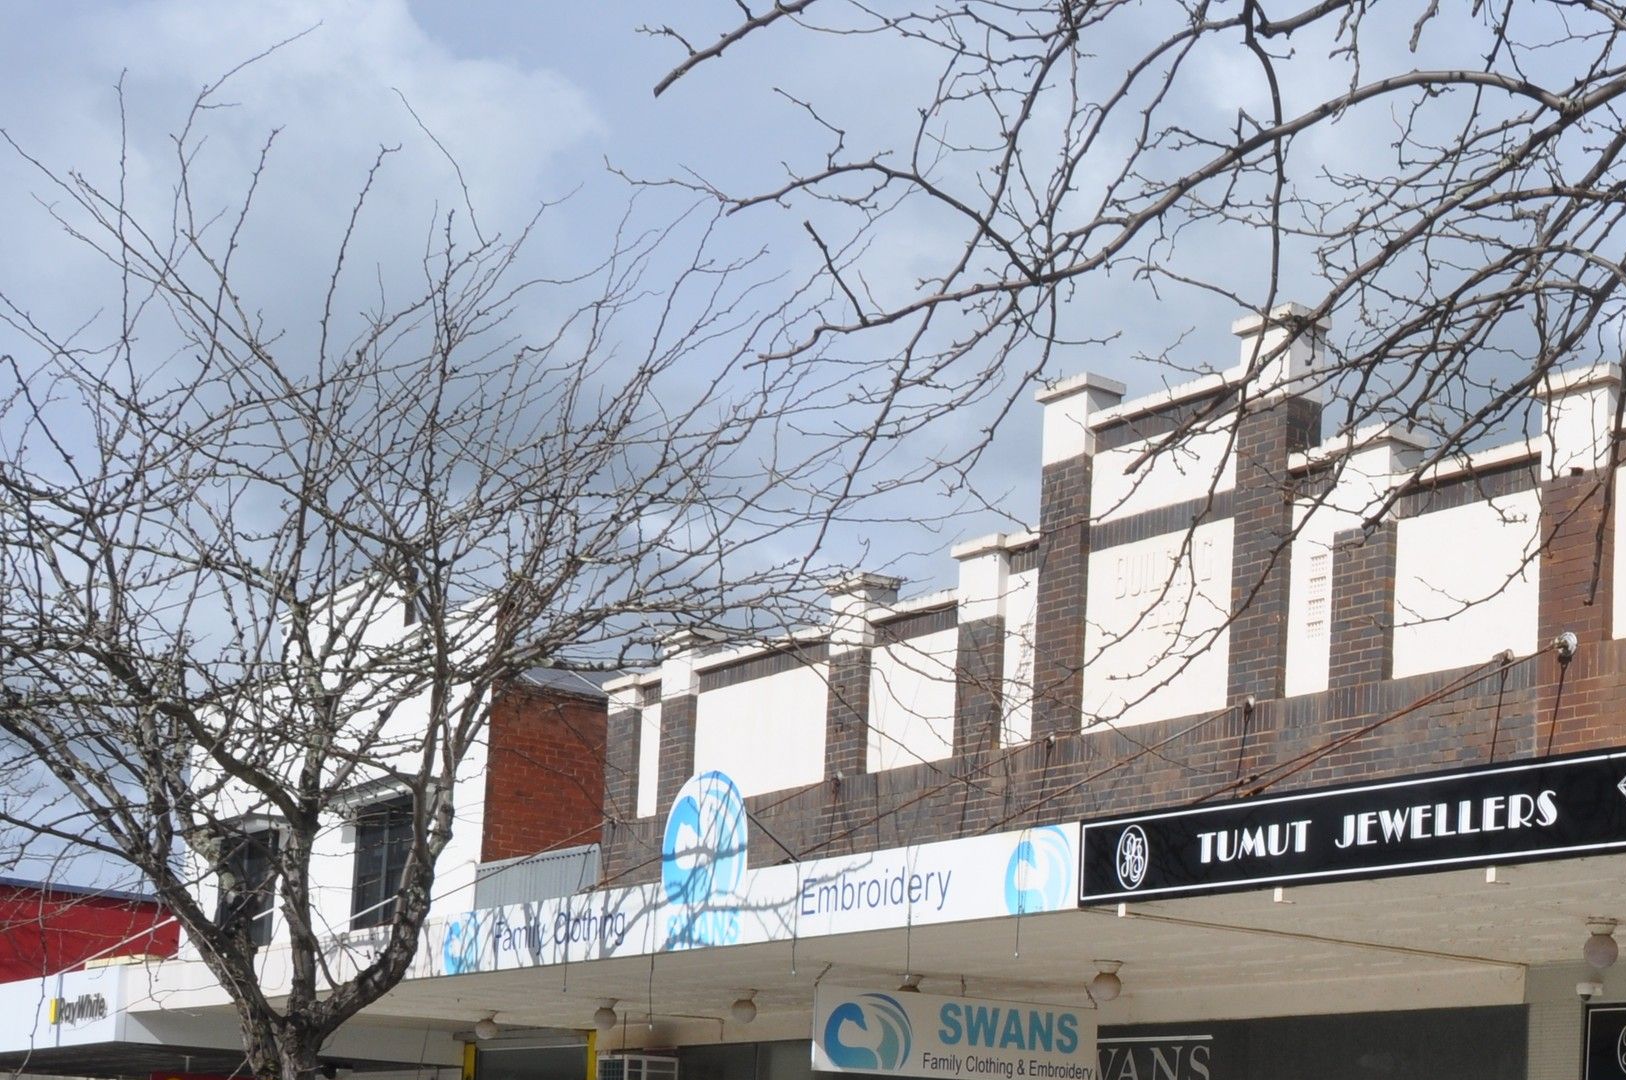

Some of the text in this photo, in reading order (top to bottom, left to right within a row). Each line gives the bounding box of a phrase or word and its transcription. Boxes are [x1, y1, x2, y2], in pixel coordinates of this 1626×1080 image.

[1197, 790, 1557, 864] TUMUT JEWELLERS
[801, 866, 952, 917] Embroidery
[495, 911, 626, 956] Family Clothing
[939, 1003, 1078, 1054] SWANS
[922, 1053, 962, 1076] Family
[965, 1055, 1013, 1079] Clothing
[1017, 1061, 1025, 1075] &
